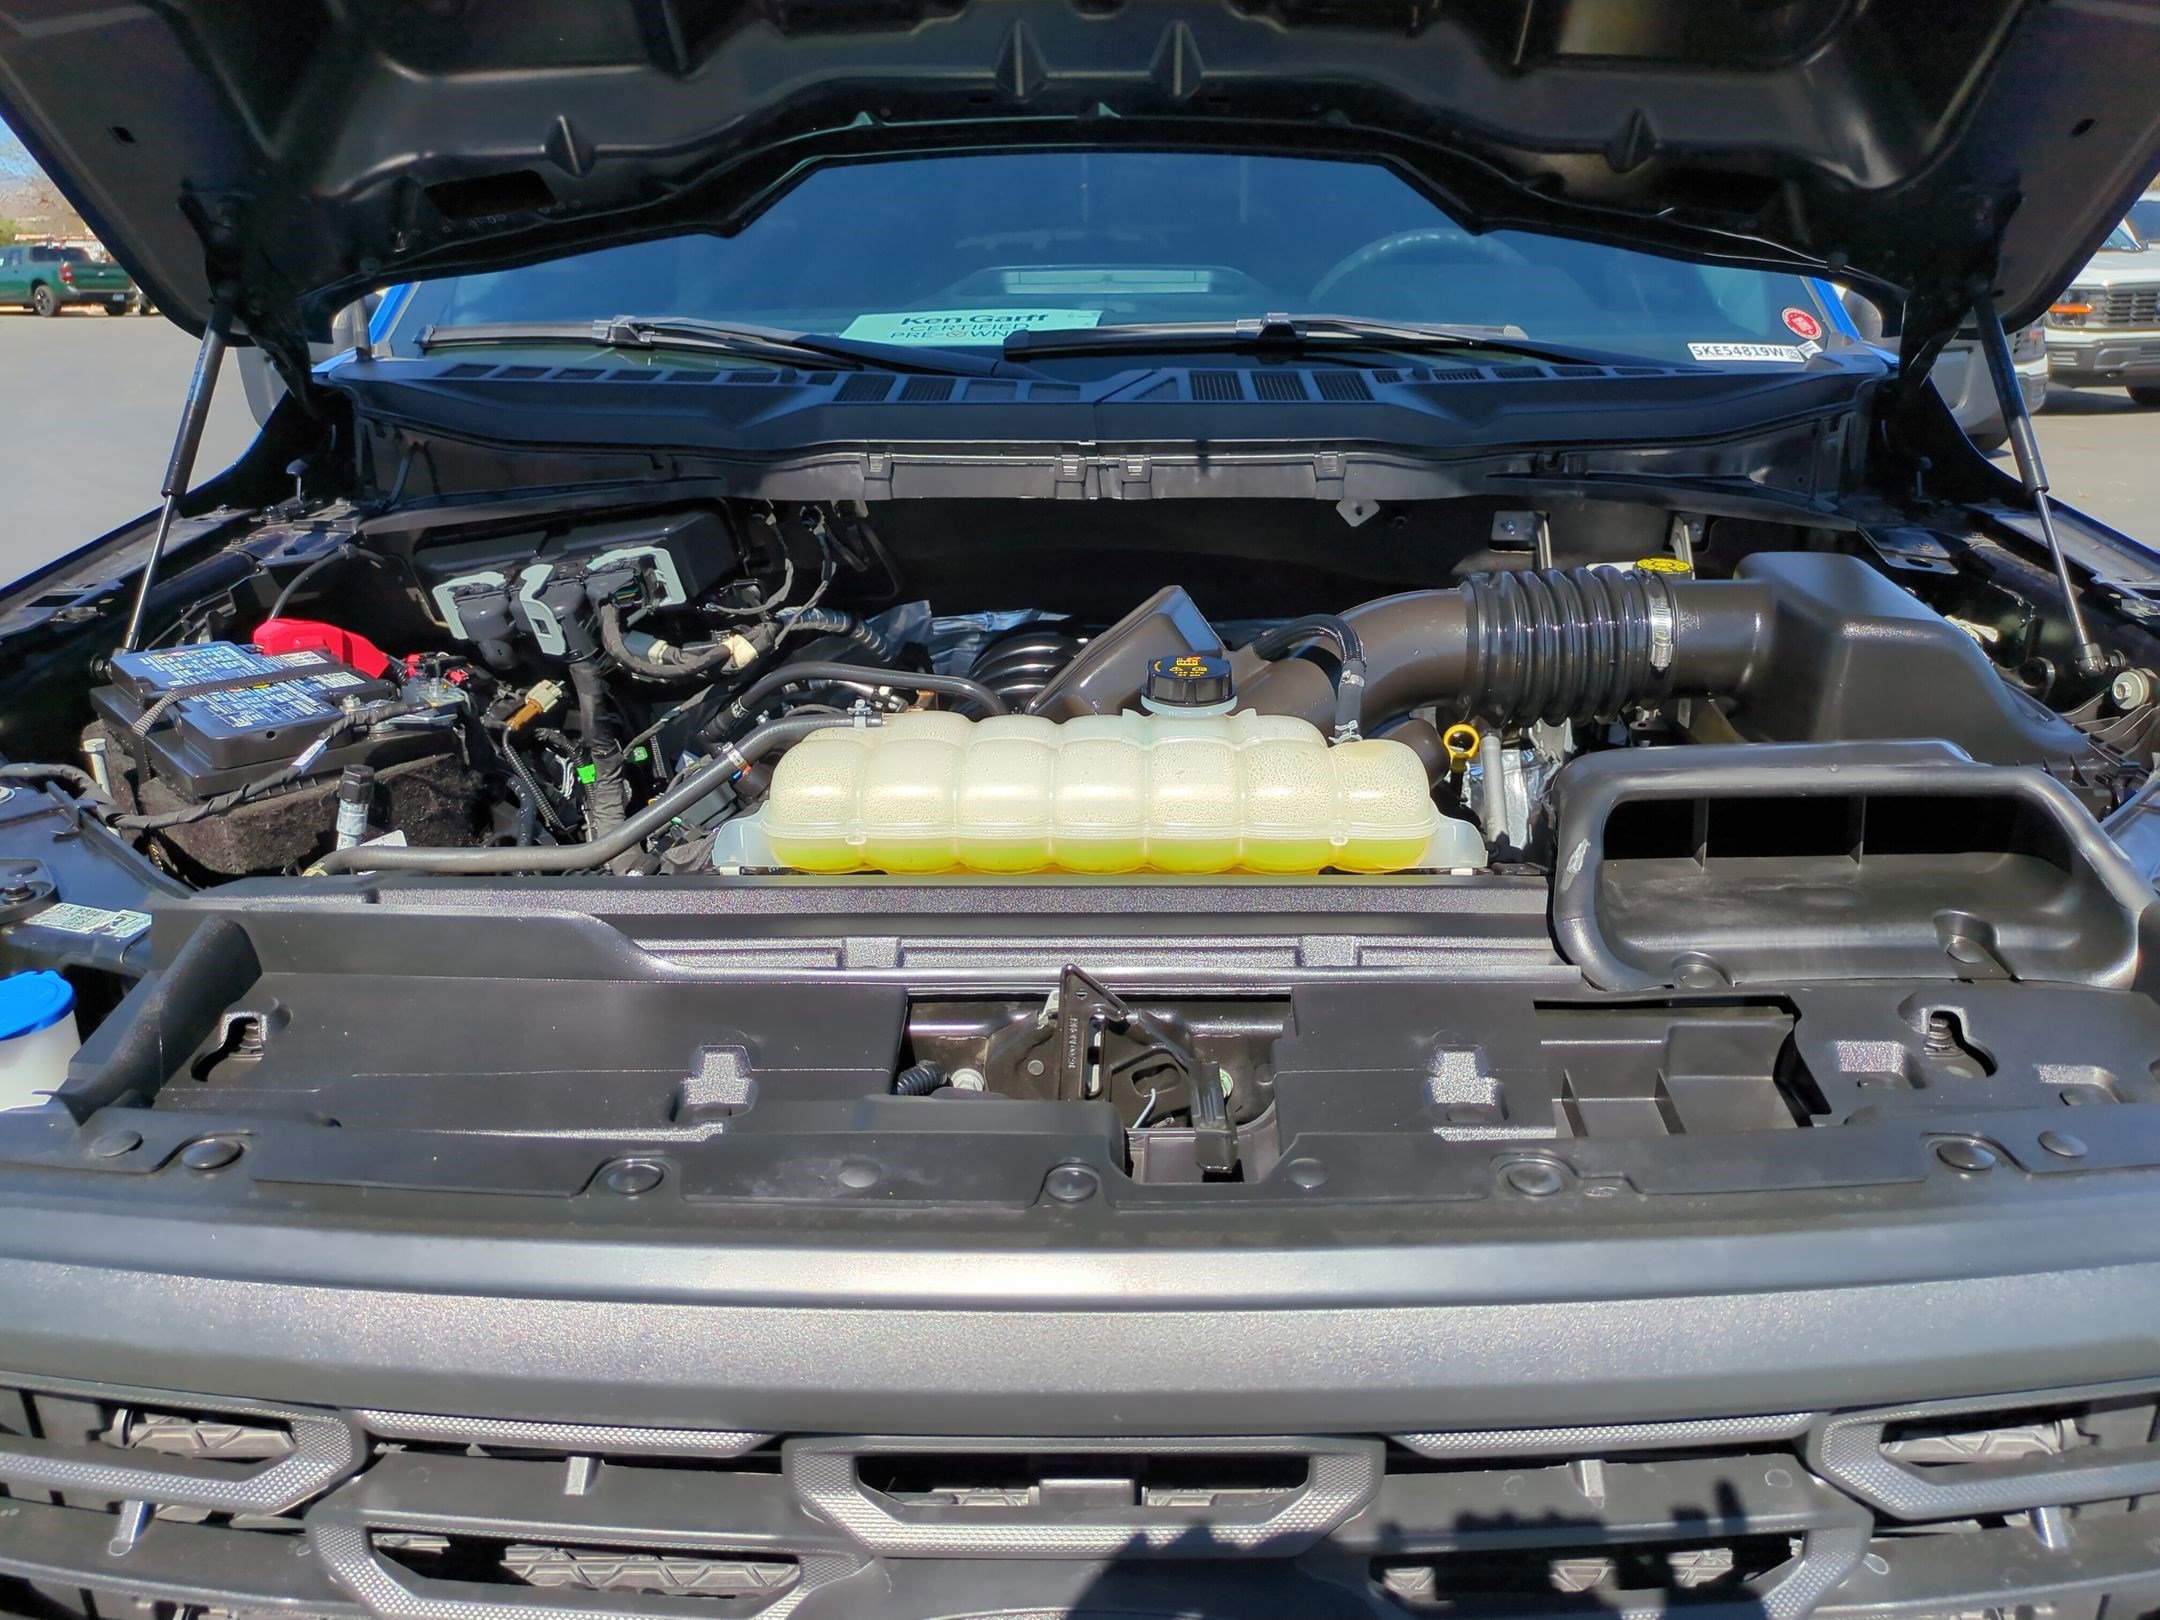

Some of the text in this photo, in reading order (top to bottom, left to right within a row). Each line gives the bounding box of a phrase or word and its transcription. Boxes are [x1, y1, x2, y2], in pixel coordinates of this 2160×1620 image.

[901, 313, 1049, 325] Ken Garff
[910, 323, 1029, 332] CERTIFIED
[890, 330, 1009, 340] PRE-OWN
